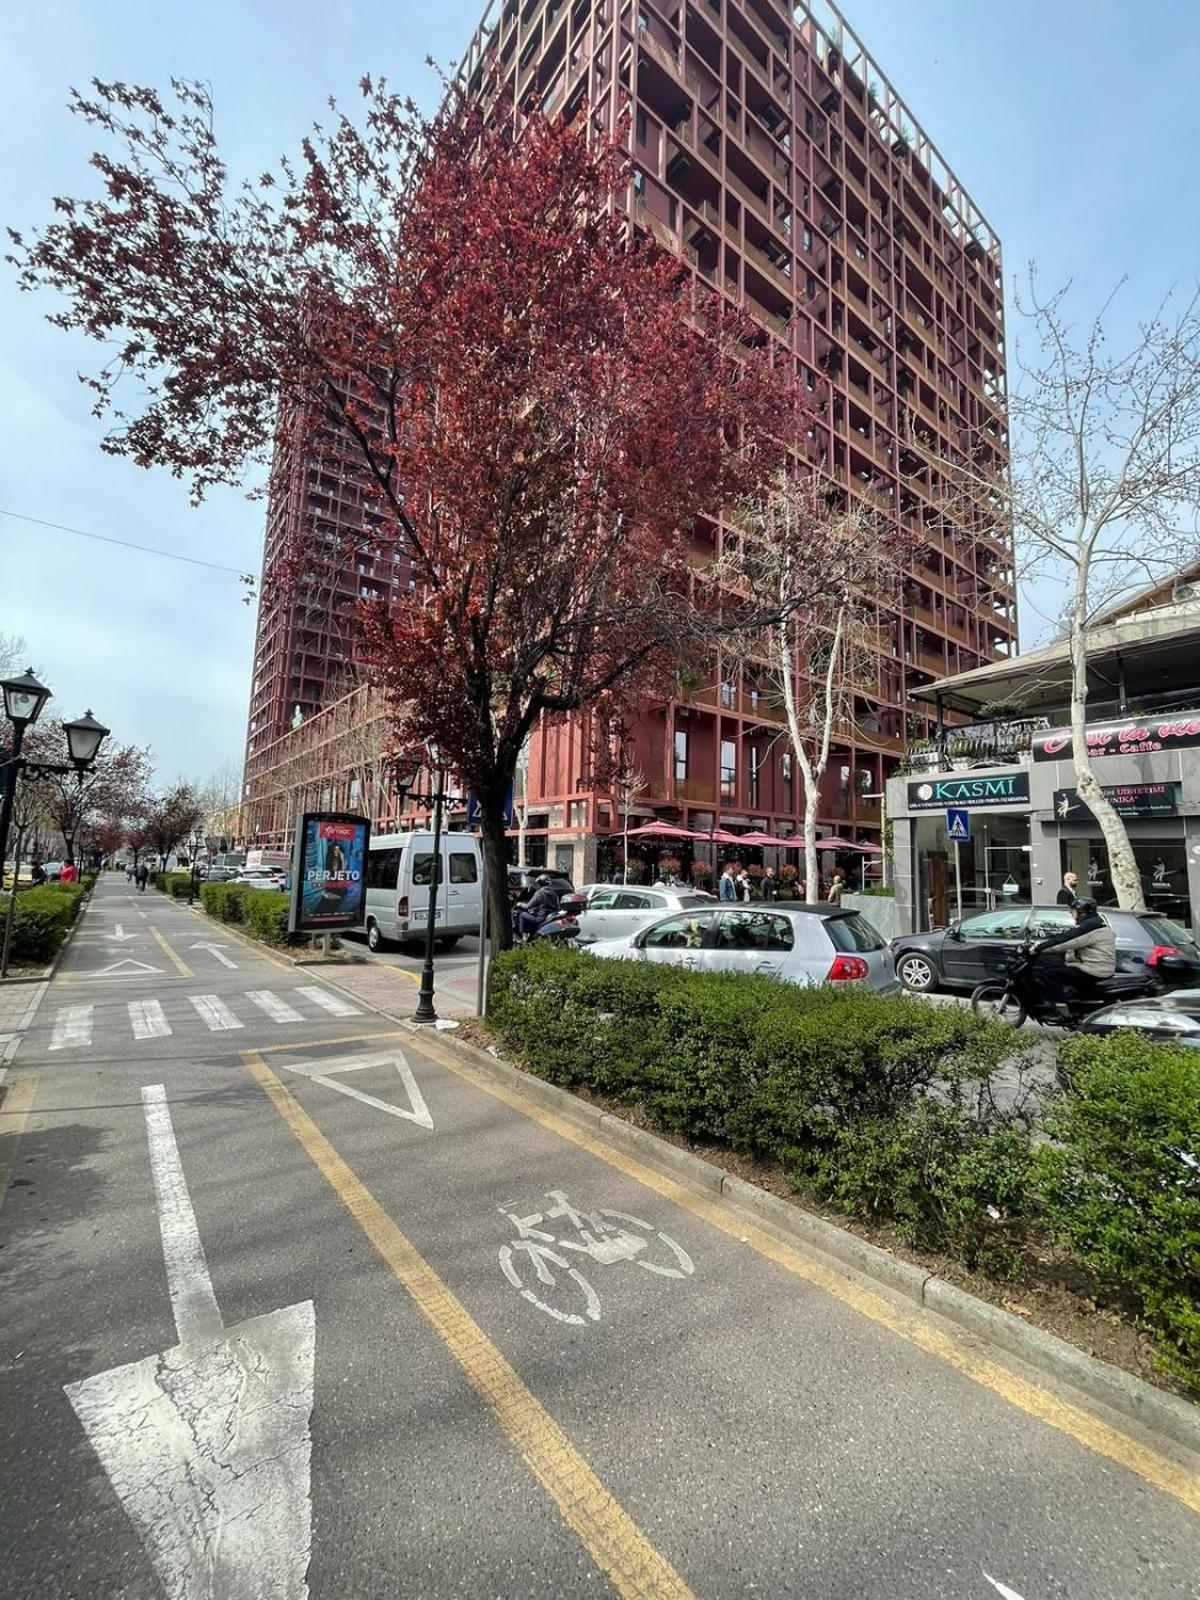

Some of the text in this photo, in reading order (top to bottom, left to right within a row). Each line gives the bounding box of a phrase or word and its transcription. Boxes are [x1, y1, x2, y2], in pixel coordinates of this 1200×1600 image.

[1118, 723, 1150, 743] la
[1087, 748, 1106, 757] ar
[1120, 741, 1162, 754] Caffe
[935, 777, 1015, 799] KASMI
[308, 870, 360, 881] PERJETO
